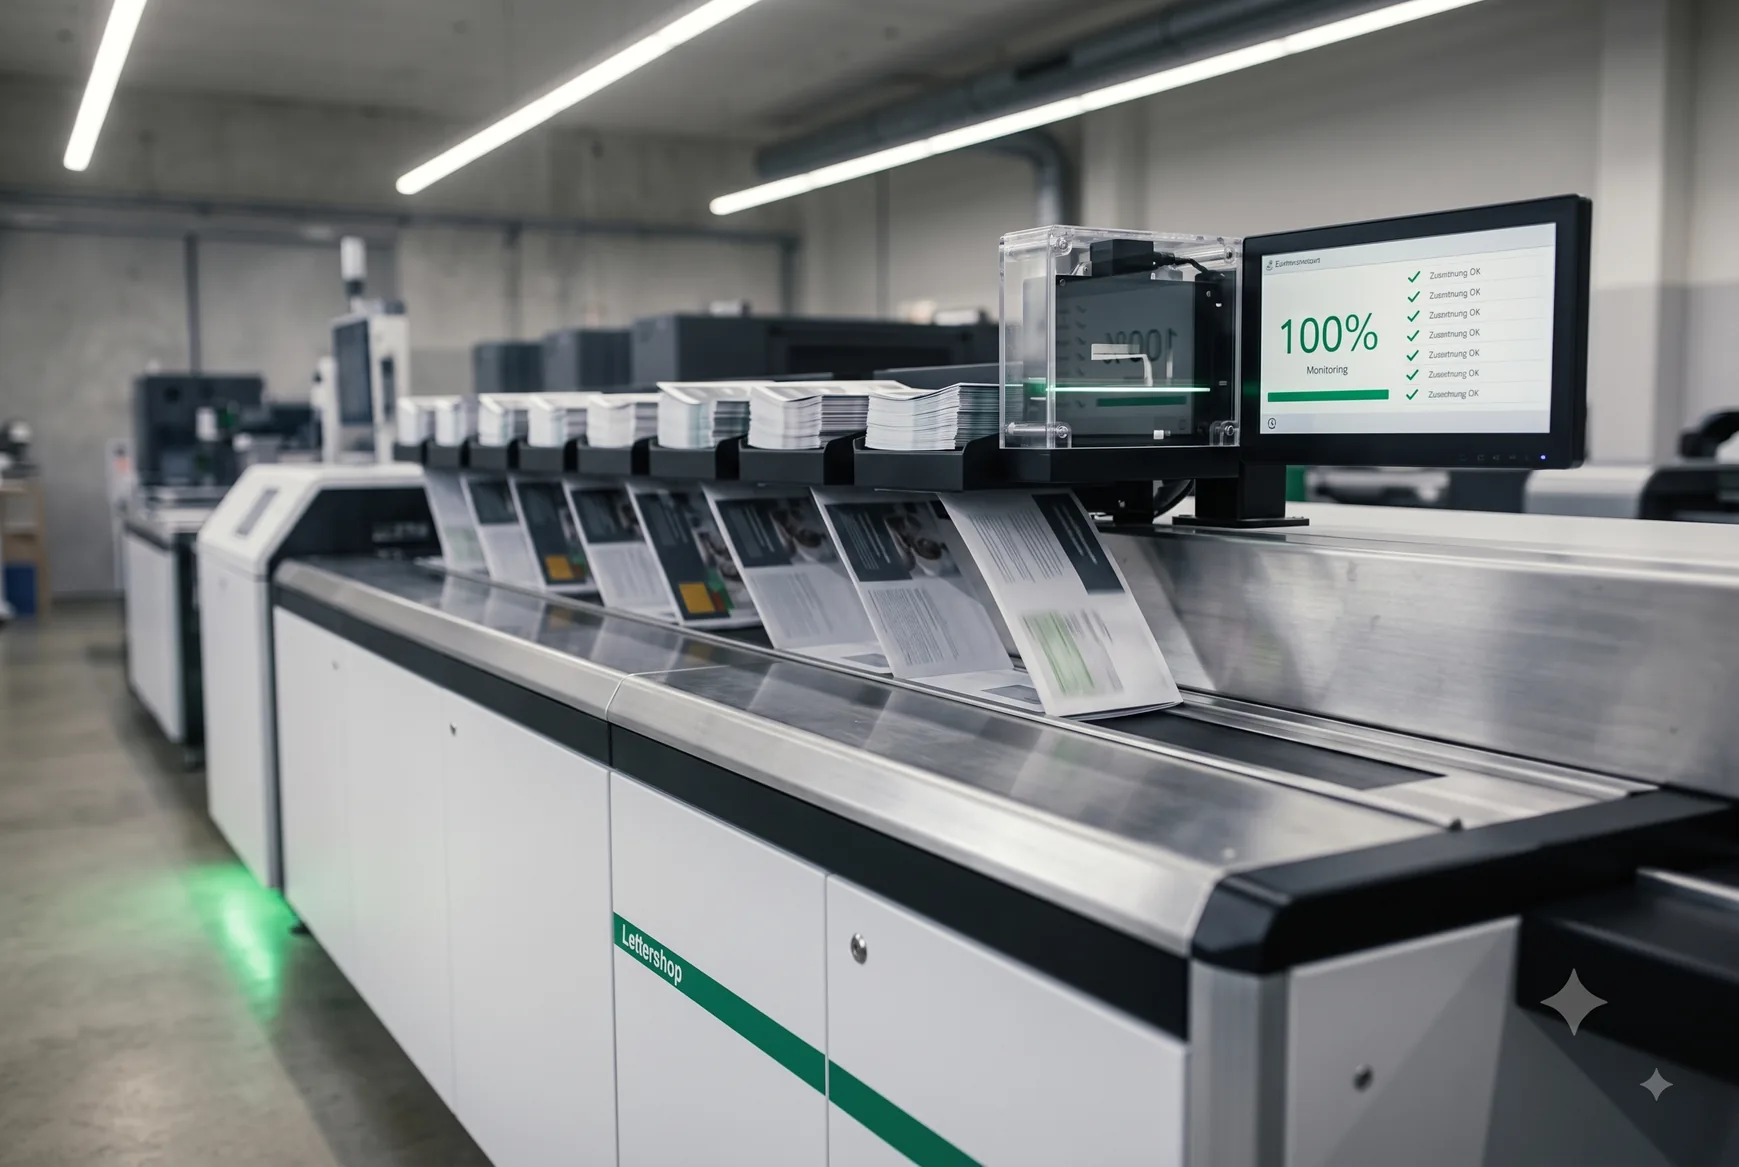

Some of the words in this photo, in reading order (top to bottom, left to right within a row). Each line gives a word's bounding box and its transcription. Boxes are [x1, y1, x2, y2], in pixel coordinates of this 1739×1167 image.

[1469, 267, 1481, 276] OK
[1469, 288, 1481, 297] OK
[1469, 308, 1481, 317] OK
[1280, 312, 1378, 354] 100%
[1468, 328, 1480, 337] OK
[1468, 348, 1480, 357] OK
[1306, 365, 1348, 376] Monitoring
[1468, 368, 1480, 377] OK
[1468, 389, 1479, 398] OK
[622, 923, 682, 986] Lettershop
